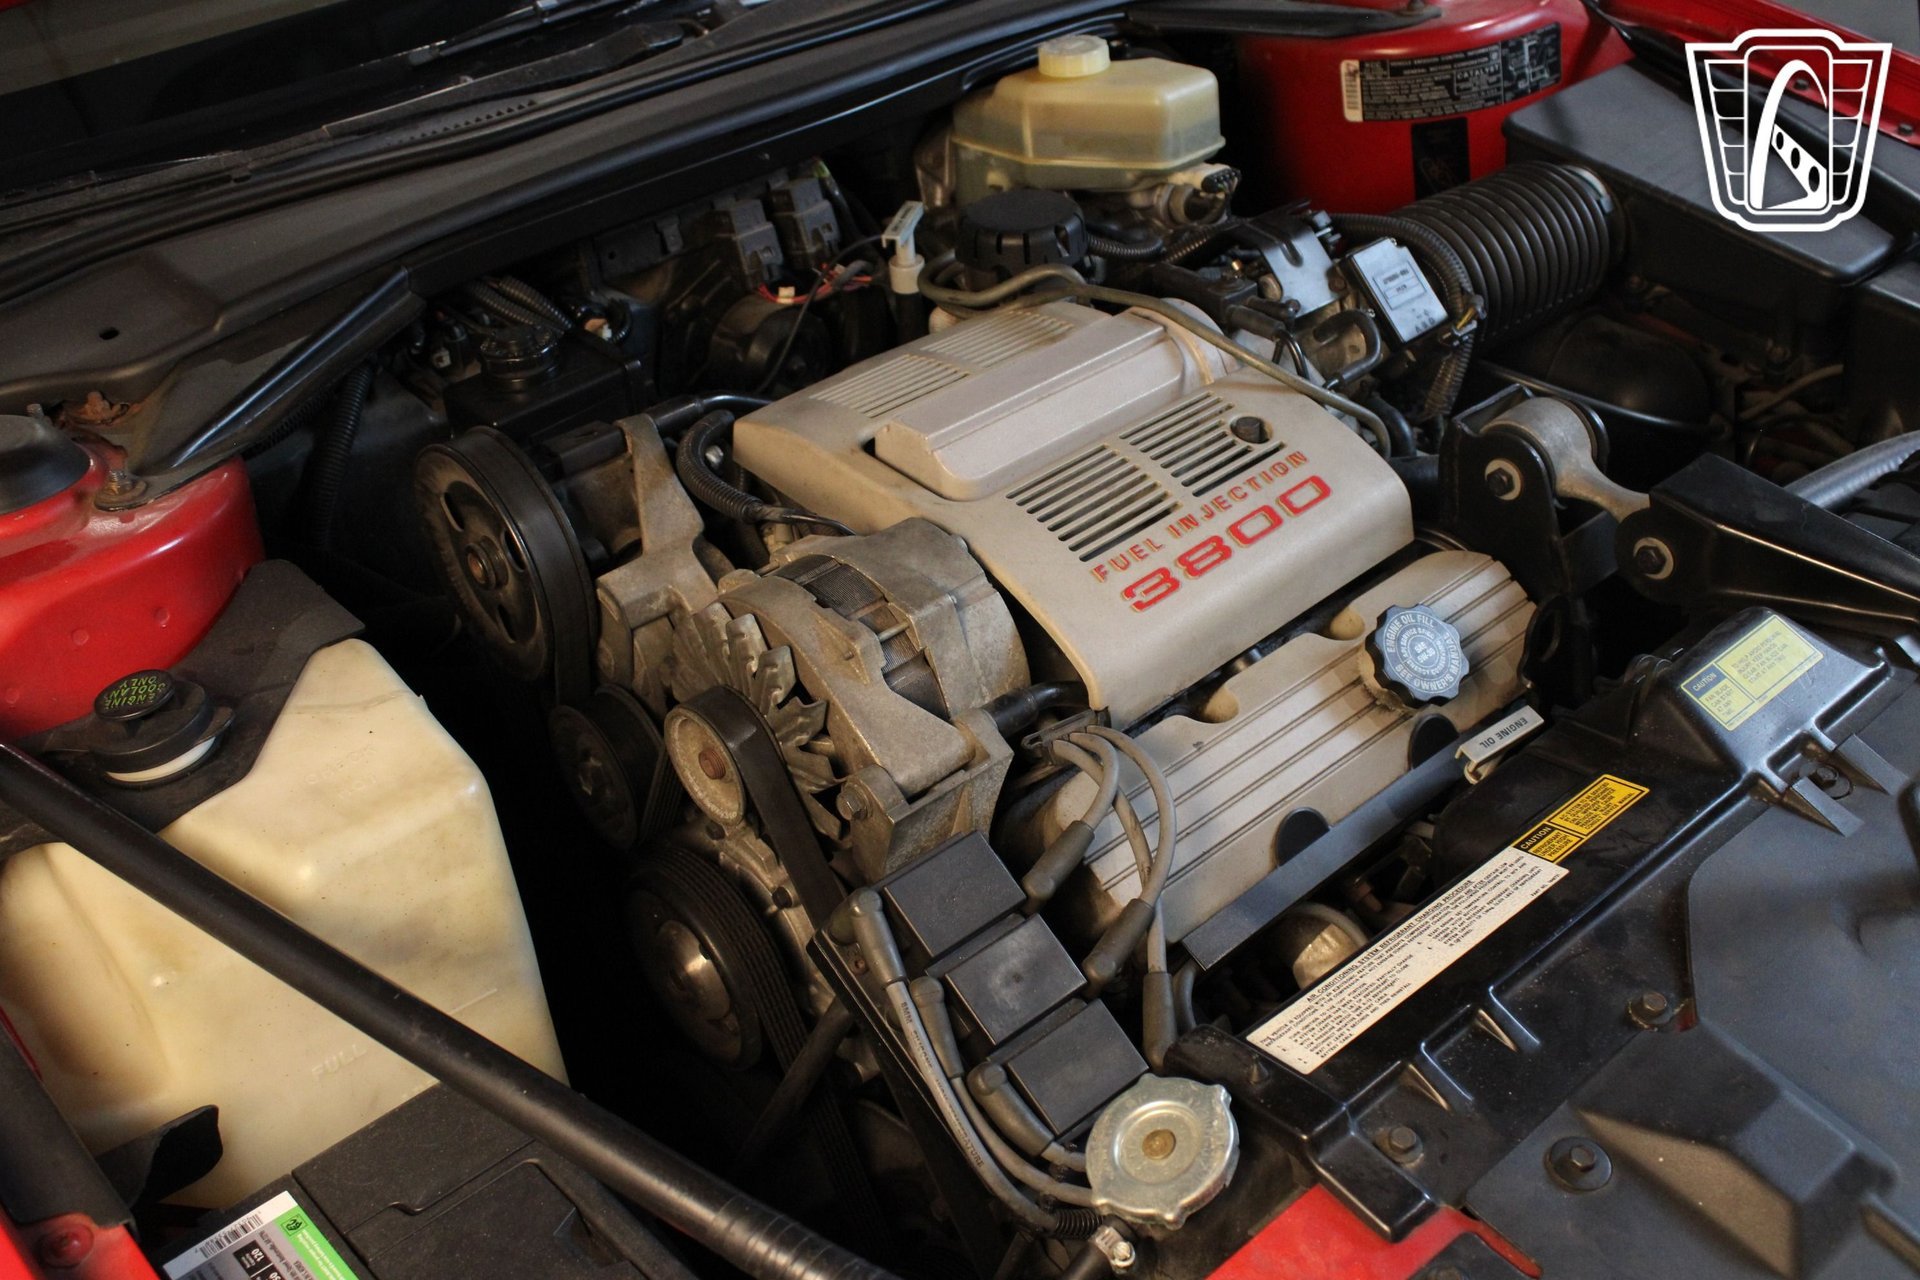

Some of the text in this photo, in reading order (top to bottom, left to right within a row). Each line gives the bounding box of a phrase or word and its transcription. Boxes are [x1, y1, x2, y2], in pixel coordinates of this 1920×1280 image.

[1456, 64, 1500, 80] CATALYST
[1091, 450, 1310, 583] FUEL INJECTION
[1120, 474, 1332, 613] 3800
[1386, 620, 1402, 653] ENGINE
[1401, 613, 1416, 626] OIL
[1417, 614, 1434, 628] FILL
[1395, 663, 1412, 682] SEE
[1414, 673, 1454, 691] OWNER'S
[1443, 632, 1460, 675] MANUAL
[120, 676, 157, 688] ONLY
[1692, 672, 1717, 692] CAUTION
[1479, 716, 1528, 749] ENGINE OIL
[1520, 826, 1552, 850] CAUTION
[1305, 879, 1473, 1002] AIR CONDITIONING SYSTEM REFRIGERANT CHARGING PROCEDURE
[902, 1002, 912, 1024] 8MM
[252, 1248, 265, 1262] 120
